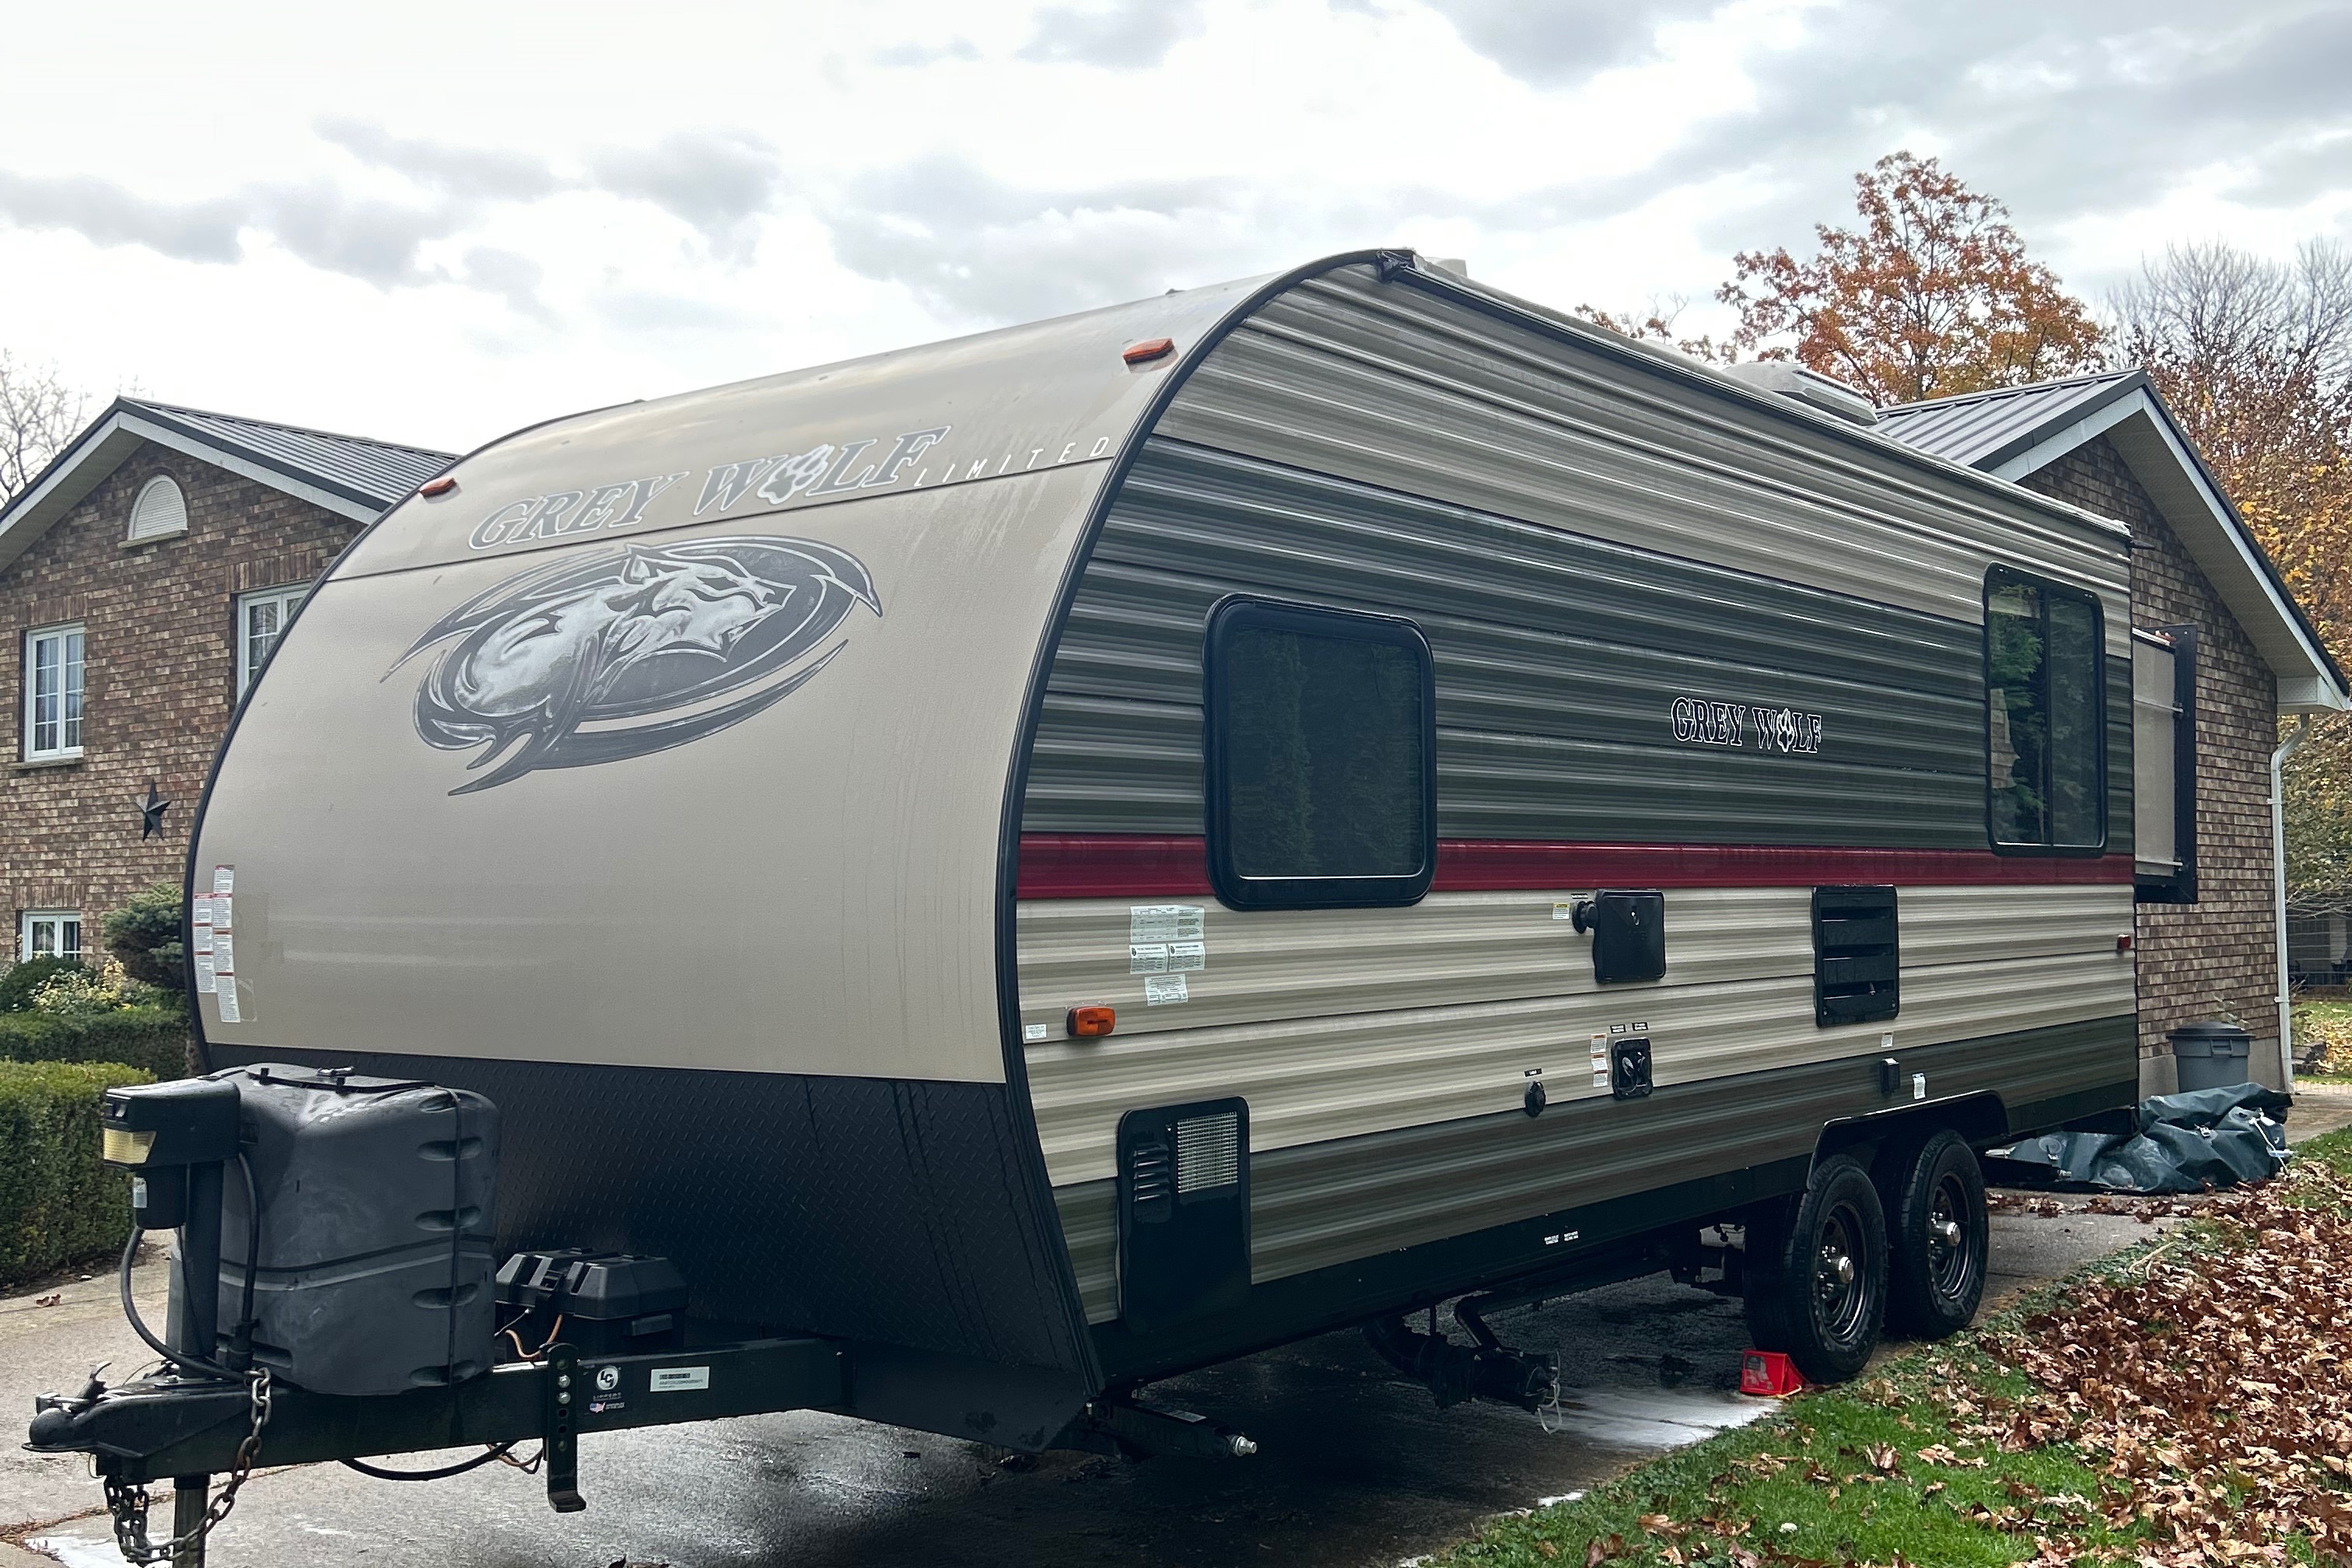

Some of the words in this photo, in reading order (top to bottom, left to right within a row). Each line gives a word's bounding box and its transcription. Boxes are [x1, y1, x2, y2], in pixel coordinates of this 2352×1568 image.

[915, 436, 1113, 488] LIMITED
[469, 469, 689, 550] GREY
[1671, 697, 1745, 747] GREY
